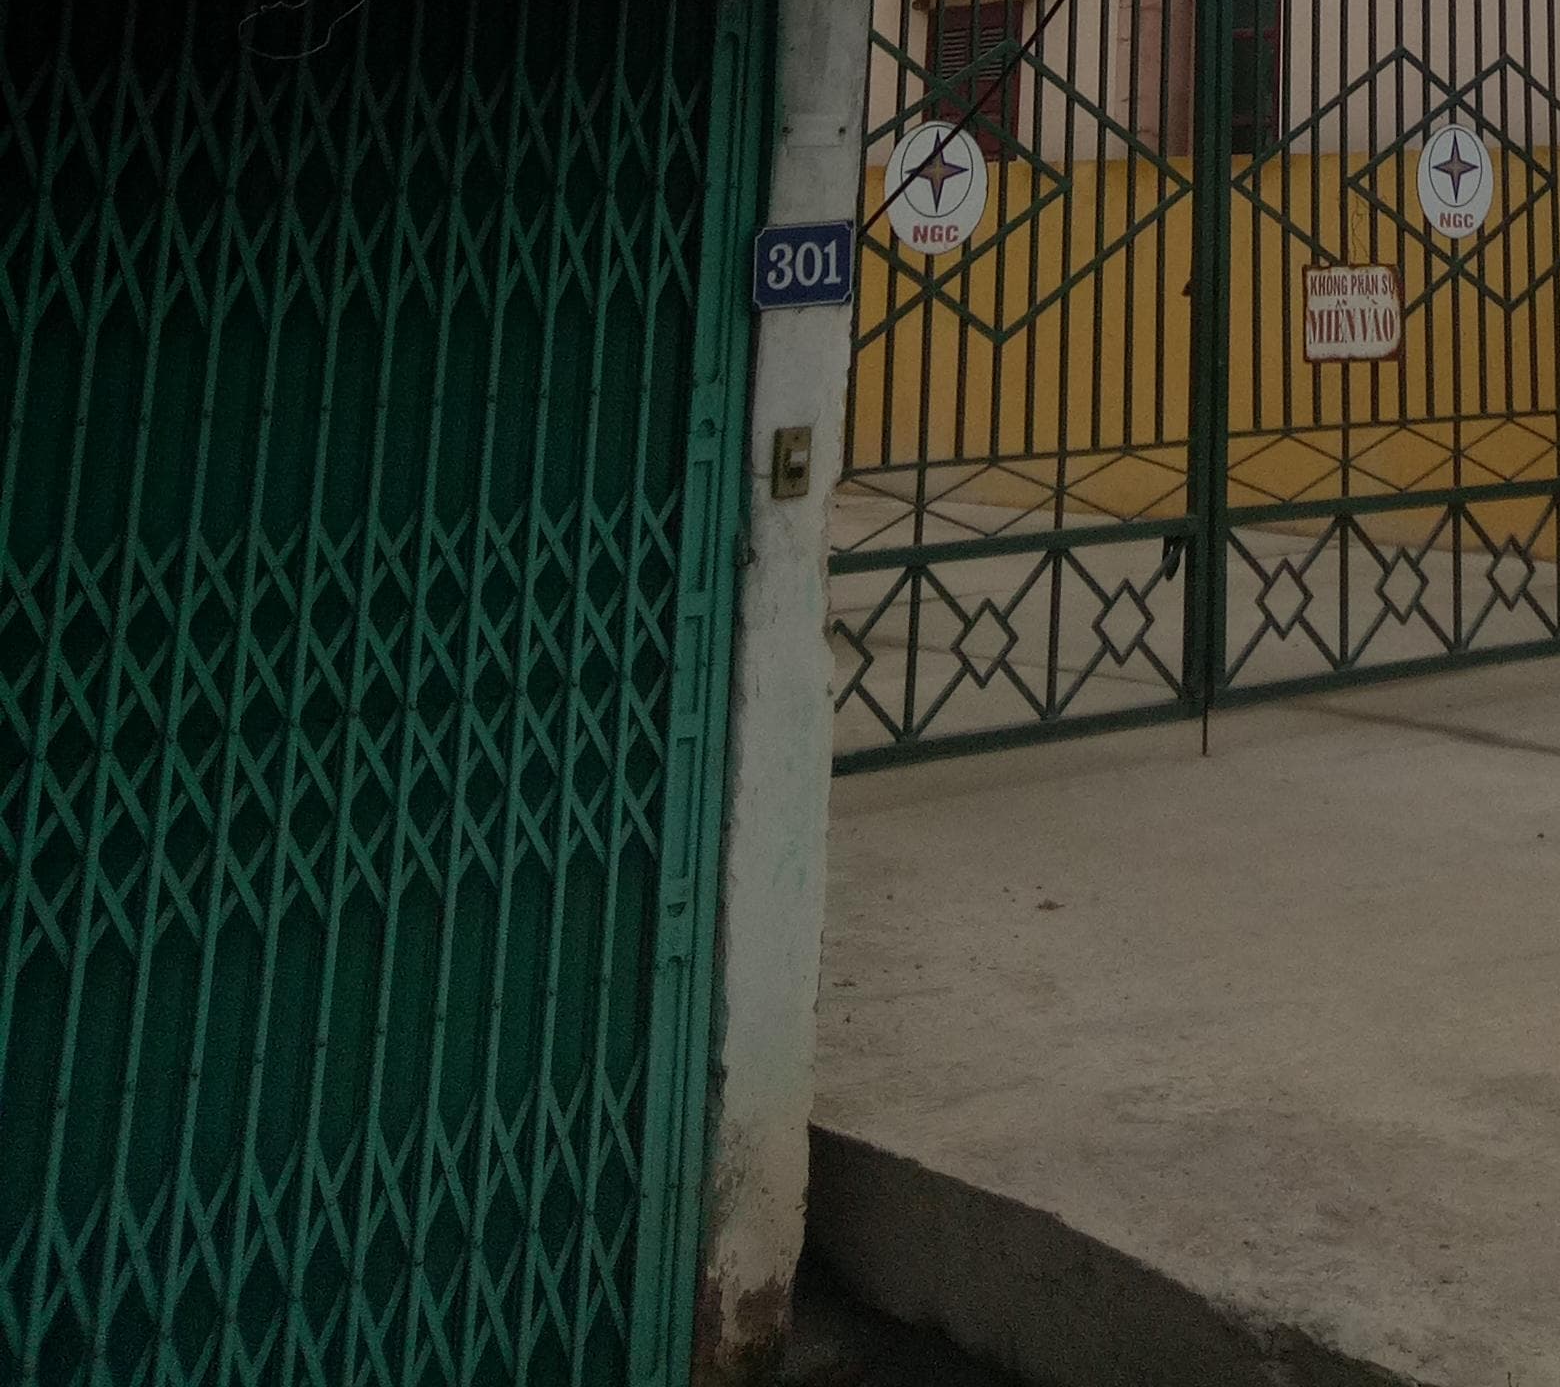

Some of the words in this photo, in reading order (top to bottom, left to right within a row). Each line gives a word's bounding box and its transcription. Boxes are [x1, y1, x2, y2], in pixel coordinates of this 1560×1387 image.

[1440, 213, 1474, 228] NGC
[912, 224, 960, 244] NGC
[767, 240, 842, 290] 301
